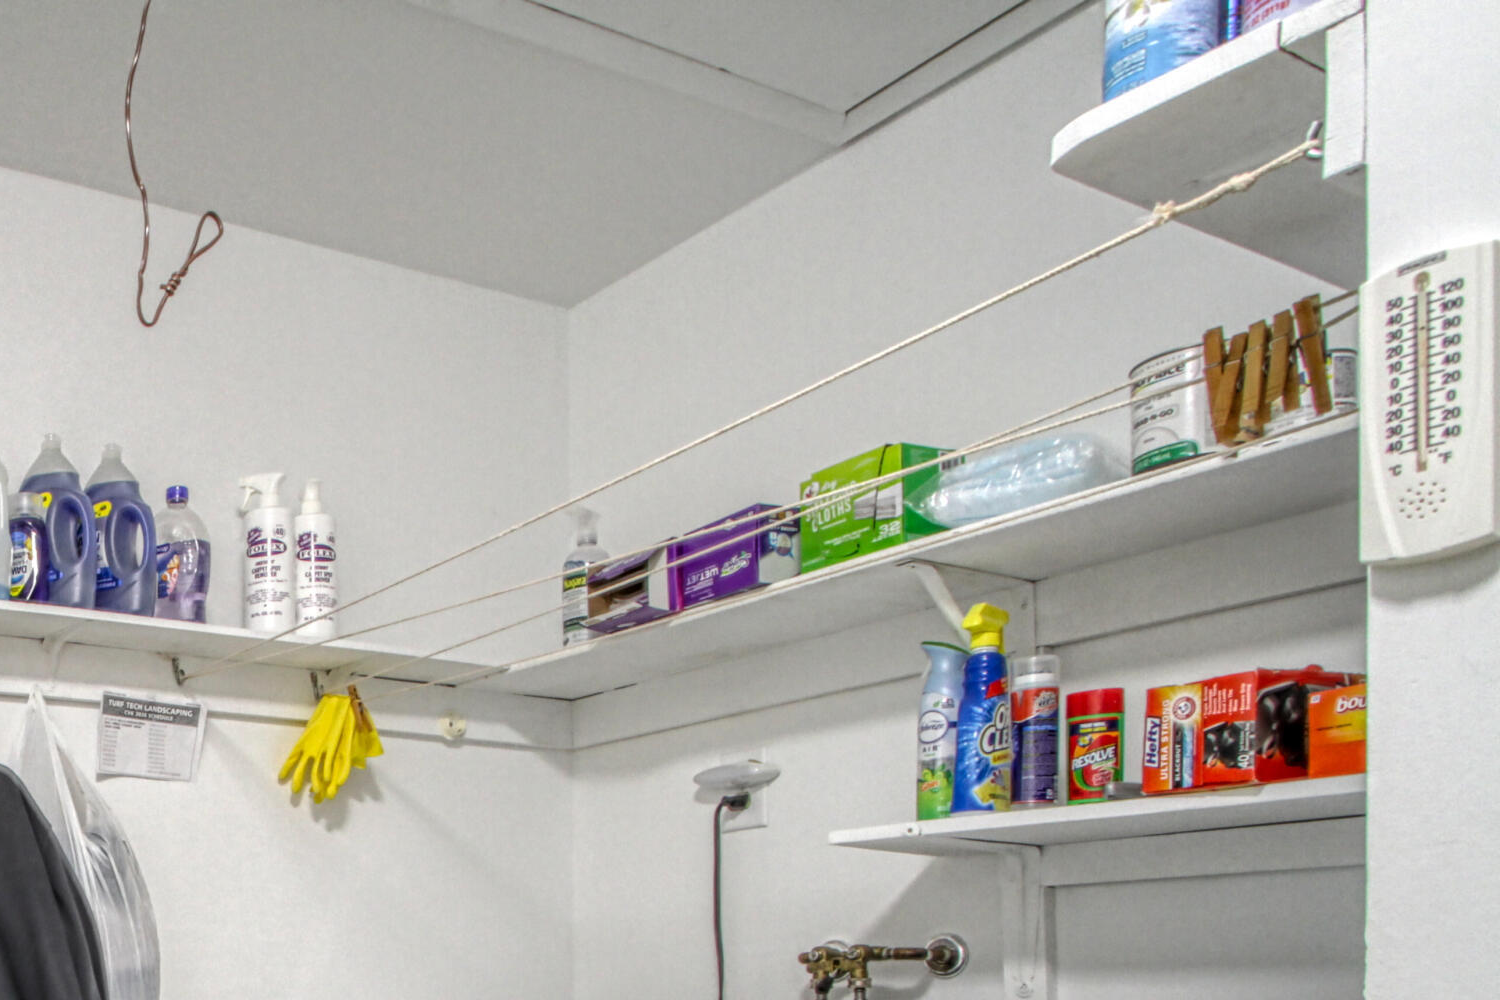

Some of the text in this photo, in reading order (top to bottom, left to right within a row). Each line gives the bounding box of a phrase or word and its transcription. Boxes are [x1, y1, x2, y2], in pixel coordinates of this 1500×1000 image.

[1441, 278, 1464, 295] 120
[1386, 297, 1403, 312] 50
[1441, 297, 1464, 312] 100
[1386, 313, 1403, 327] 40
[1442, 316, 1461, 330] 80
[1386, 328, 1403, 344] 30
[1442, 334, 1461, 348] 60
[1386, 345, 1403, 359] 20
[1442, 352, 1461, 365] 40
[1388, 361, 1403, 374] 10
[1390, 378, 1400, 389] 0
[1442, 370, 1461, 384] 20
[1388, 393, 1403, 406] 10
[1446, 389, 1456, 402] 0
[1386, 408, 1403, 422] 20
[1442, 407, 1461, 421] 20
[1386, 424, 1403, 438] 30
[1442, 425, 1461, 439] 40
[1386, 440, 1403, 454] 40
[108, 699, 193, 717] TURF TECH LANDSCAPING
[1146, 720, 1161, 764] Hefty
[1072, 746, 1117, 771] RESOLVE
[1160, 744, 1169, 781] ULTRA
